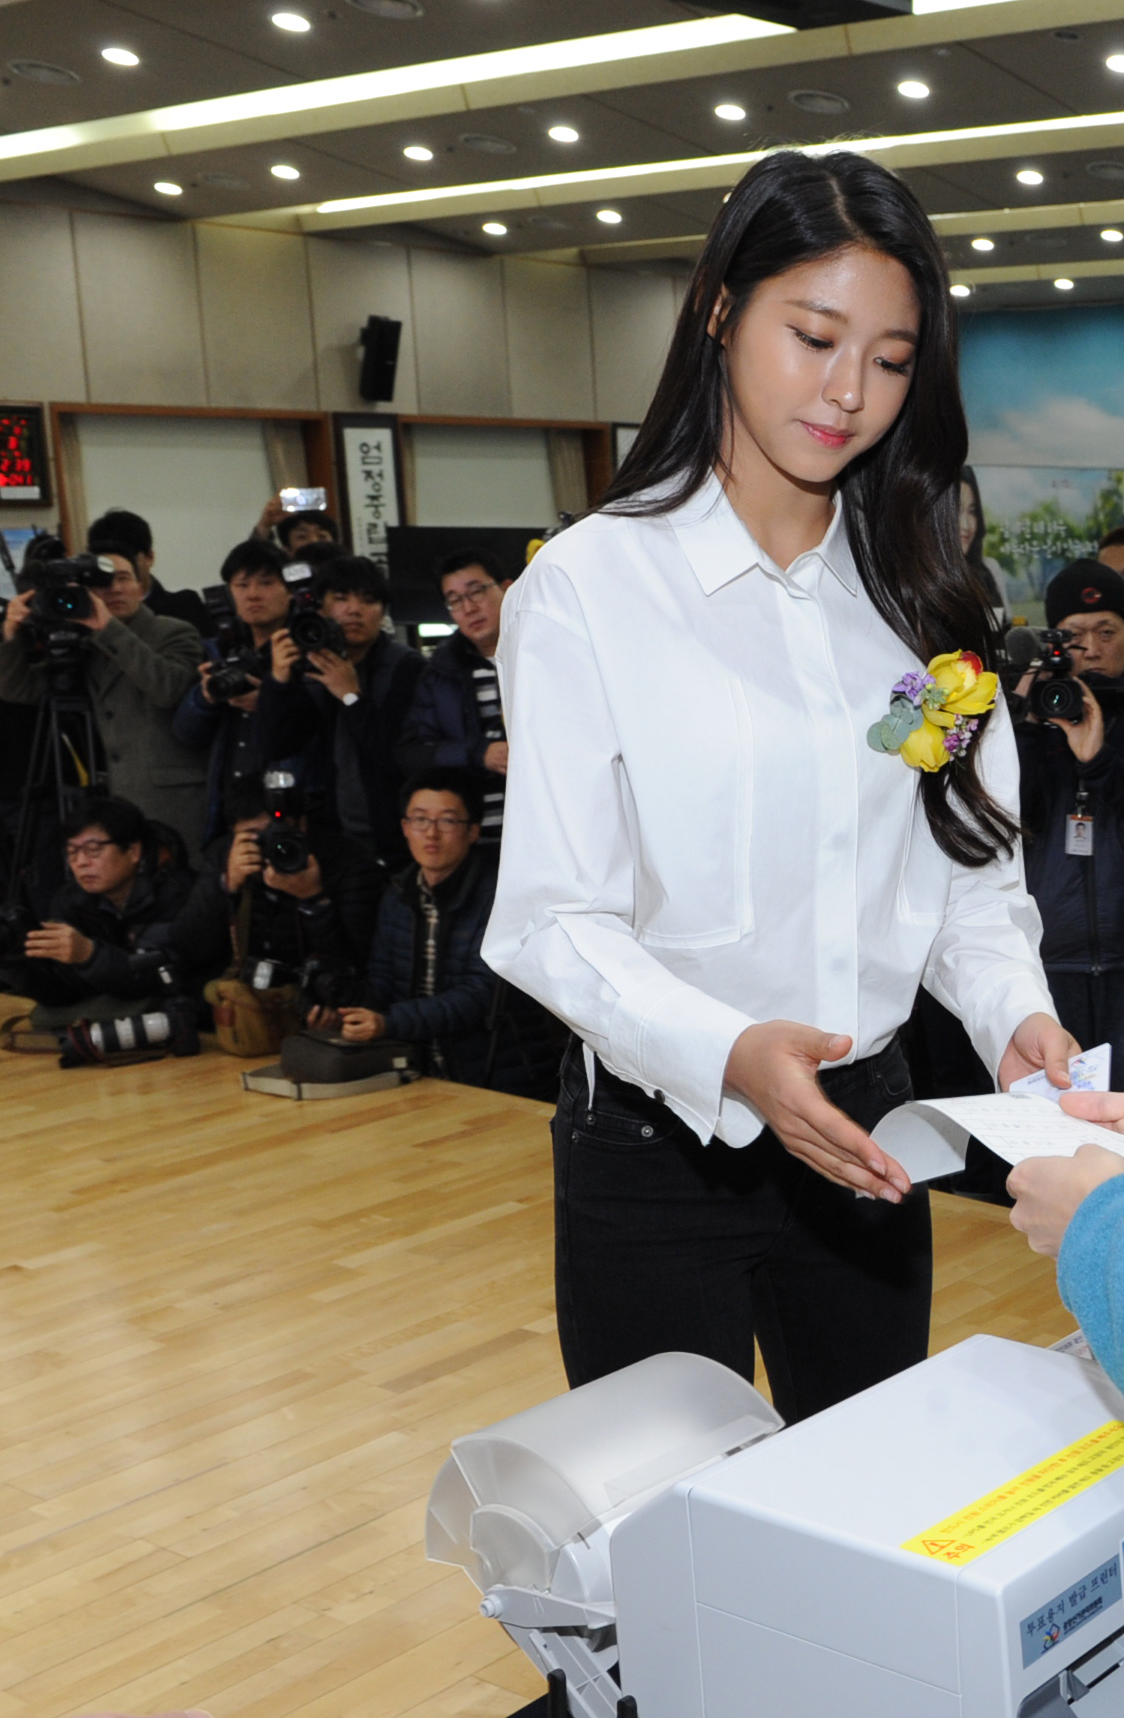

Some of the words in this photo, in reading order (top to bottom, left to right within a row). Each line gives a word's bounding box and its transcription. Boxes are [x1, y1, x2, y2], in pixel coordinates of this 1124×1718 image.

[943, 1543, 975, 1560] 주의
[1026, 1600, 1065, 1636] 투표용지
[1069, 1585, 1087, 1608] 발급
[1091, 1562, 1118, 1593] 프린터
